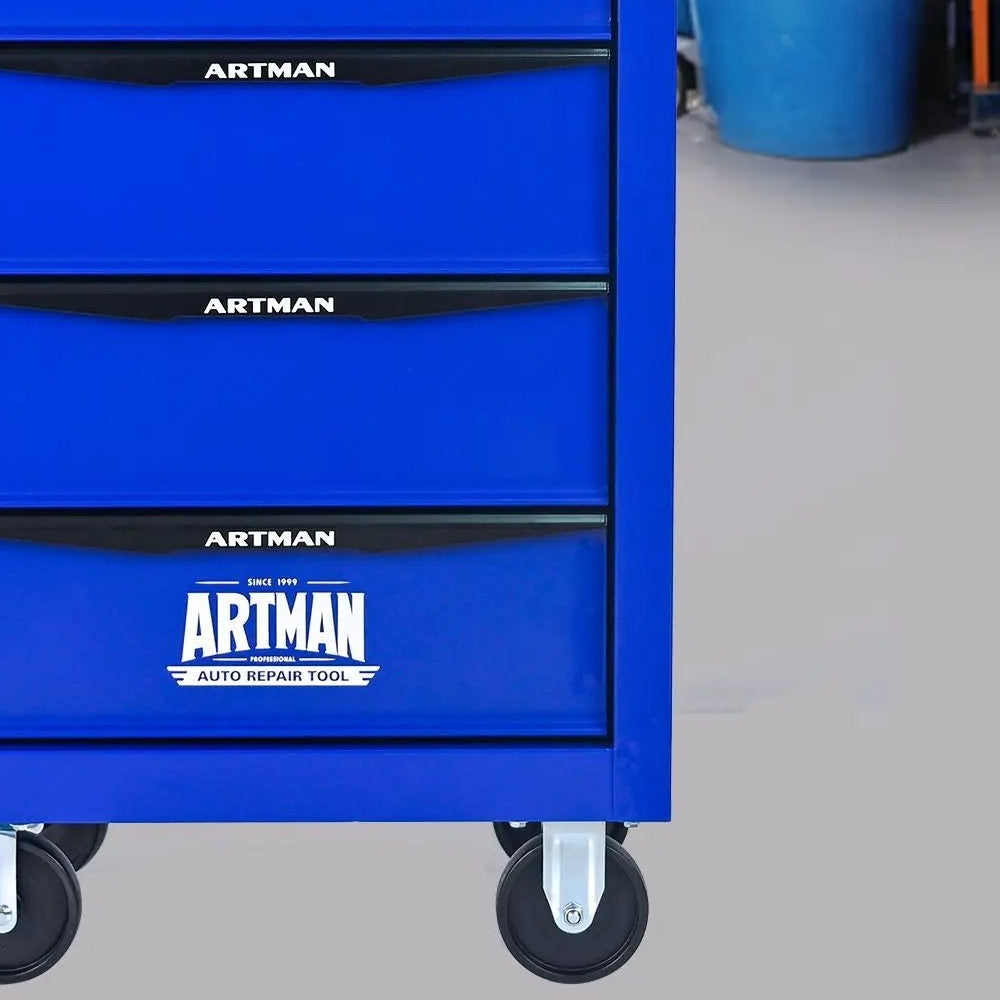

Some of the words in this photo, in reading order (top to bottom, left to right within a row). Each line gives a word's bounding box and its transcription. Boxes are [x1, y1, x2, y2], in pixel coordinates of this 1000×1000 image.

[204, 62, 336, 79] ARTMAN
[203, 297, 335, 314] ARTMAN
[204, 530, 335, 547] ARTMAN
[247, 578, 272, 587] SINCE
[277, 578, 298, 586] 1999
[181, 591, 366, 663] ARTMAN
[249, 655, 296, 663] PROFESSIONAL
[197, 670, 241, 682] AUTO
[247, 670, 302, 682] REPAIR
[308, 670, 349, 682] TOOL
